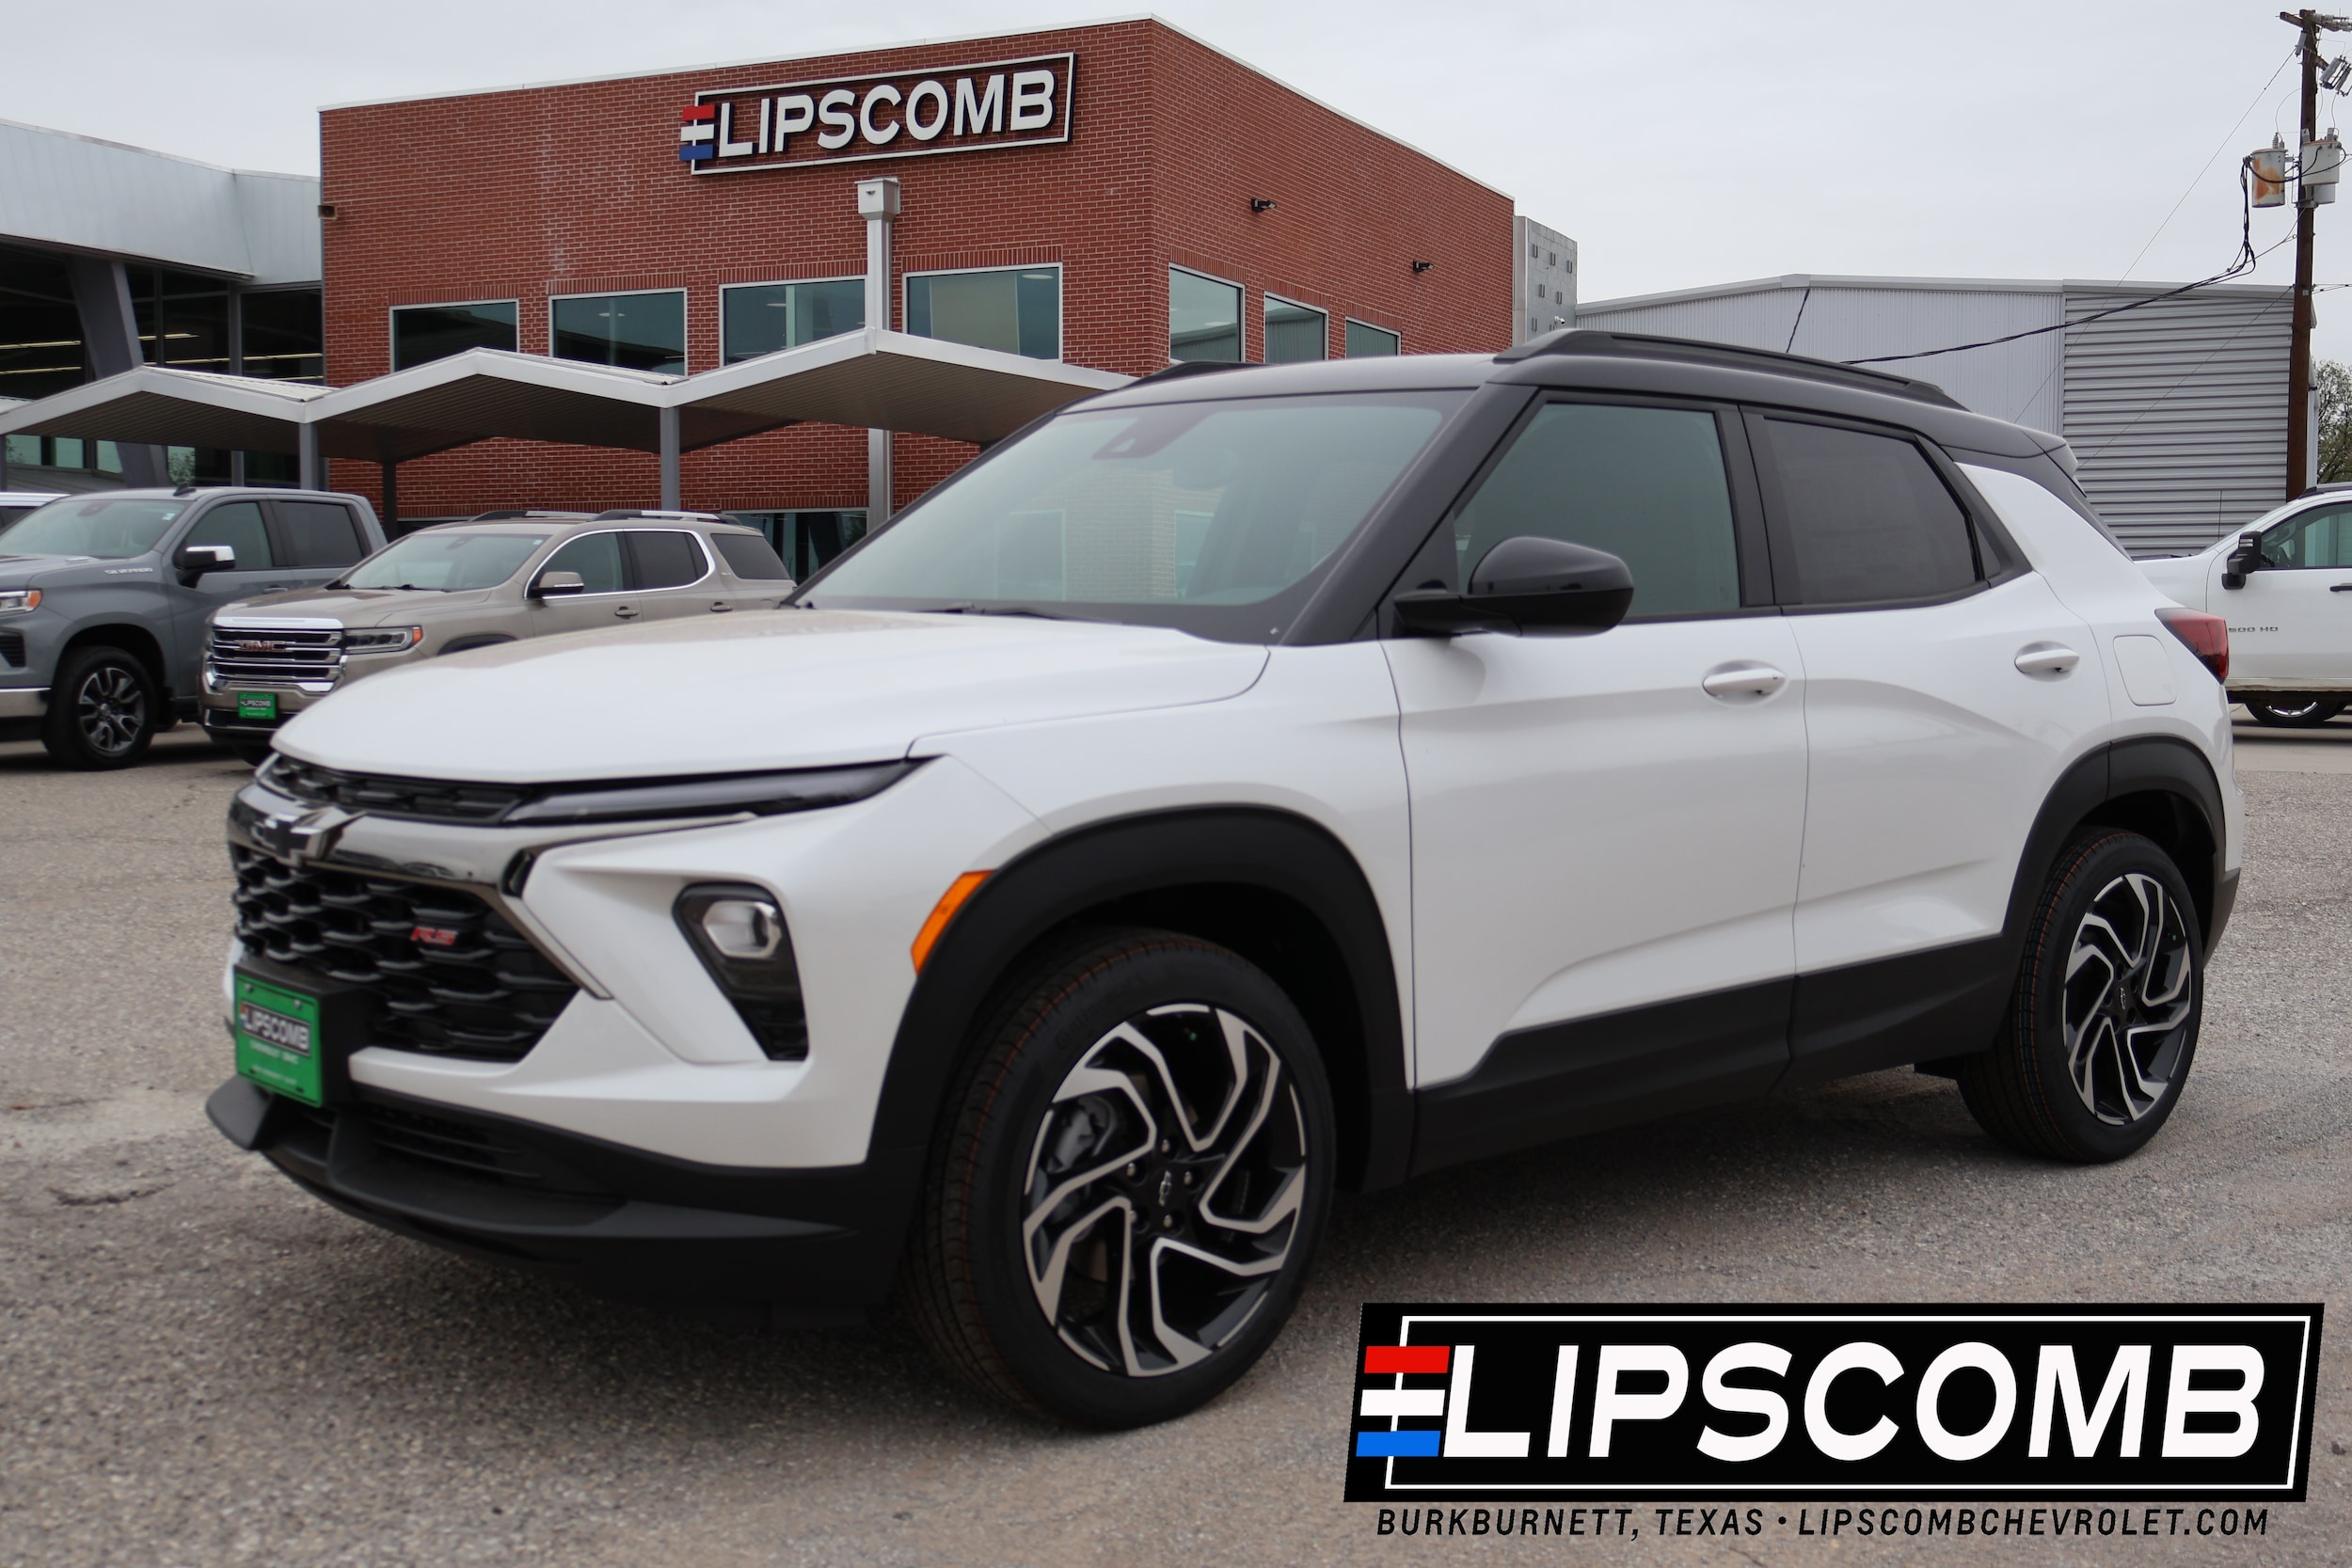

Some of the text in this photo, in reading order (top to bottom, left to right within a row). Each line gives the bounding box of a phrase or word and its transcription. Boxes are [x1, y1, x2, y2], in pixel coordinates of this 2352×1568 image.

[719, 69, 1055, 157] LIPSCOMB
[239, 640, 287, 653] GMC
[410, 926, 458, 946] RS
[245, 1006, 310, 1051] LIPSCOMB
